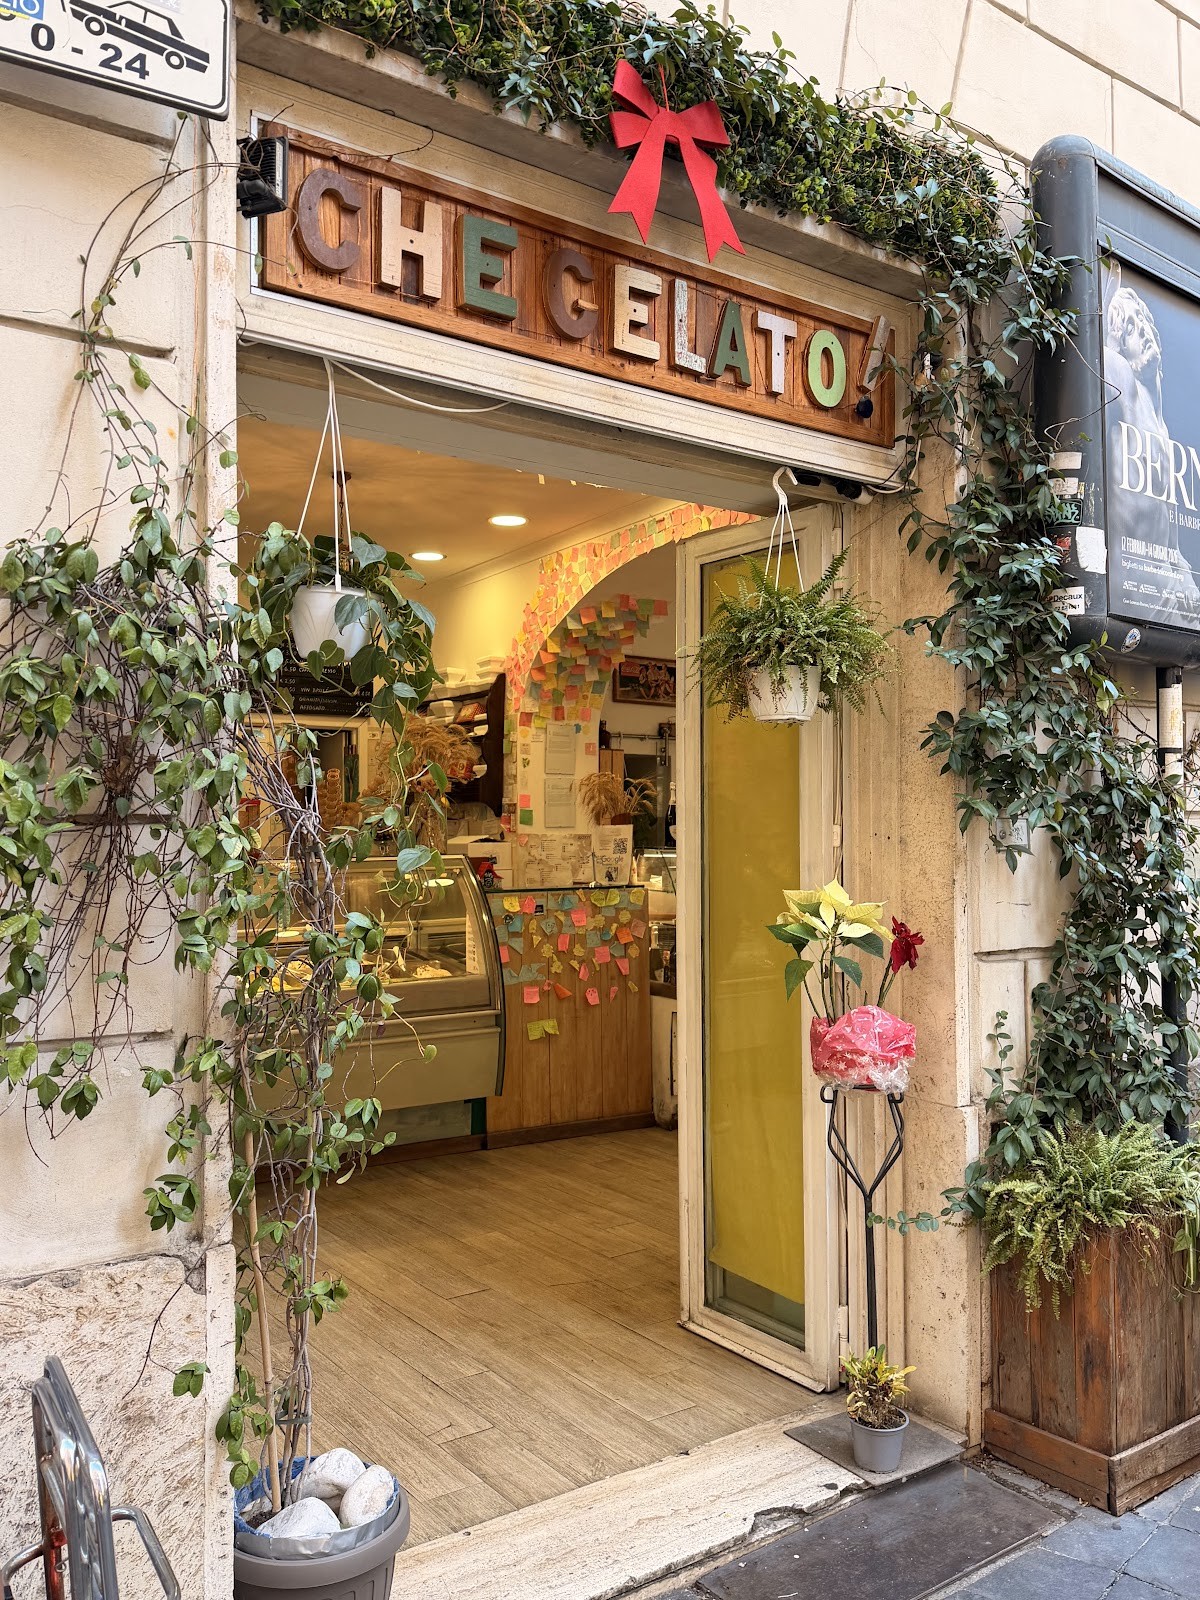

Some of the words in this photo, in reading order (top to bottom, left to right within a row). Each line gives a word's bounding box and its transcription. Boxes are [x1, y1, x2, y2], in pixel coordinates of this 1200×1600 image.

[31, 23, 56, 51] 0
[98, 43, 149, 80] 24
[296, 166, 519, 322] CHE
